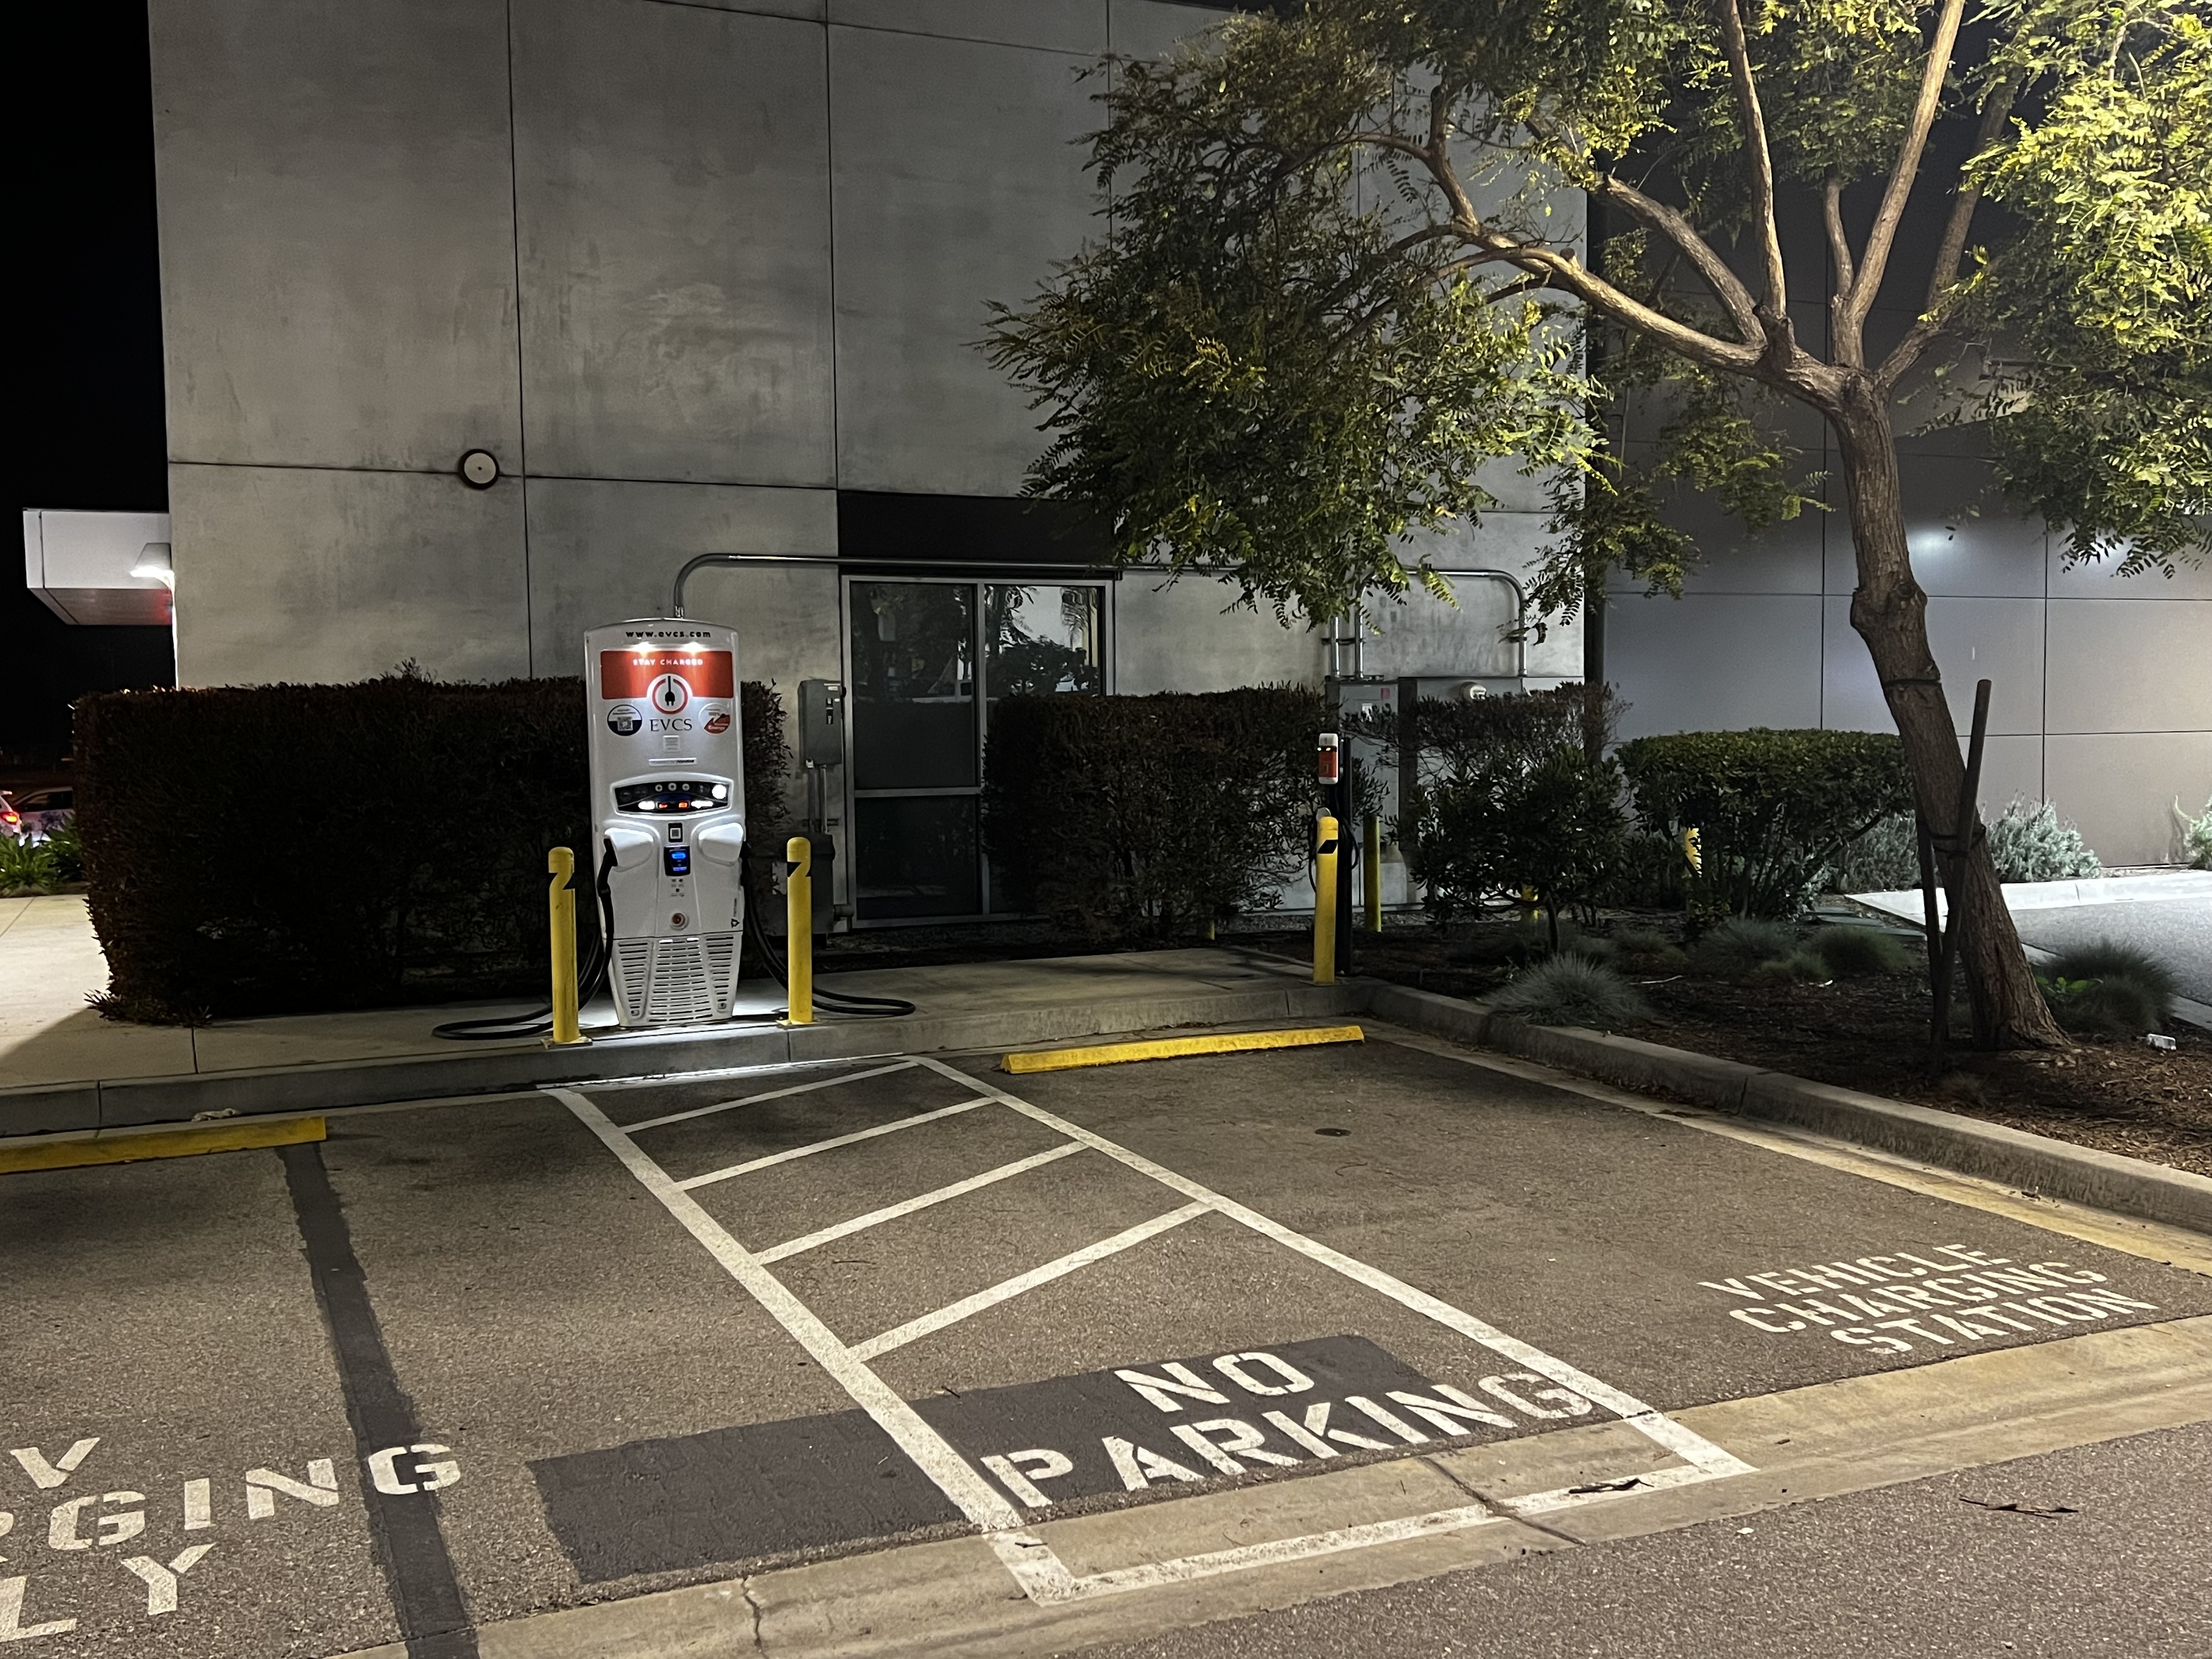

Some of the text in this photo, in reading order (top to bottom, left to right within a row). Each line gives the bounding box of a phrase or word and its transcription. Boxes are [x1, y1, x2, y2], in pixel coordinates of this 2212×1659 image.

[650, 718, 692, 732] EVCS
[1697, 1244, 2012, 1300] VEHICLE
[1729, 1261, 2108, 1333] CHARGING
[1831, 1289, 2159, 1355] STATION
[1115, 1351, 1315, 1412] NO
[981, 1372, 1593, 1508] PARKING
[0, 1443, 461, 1562] GING
